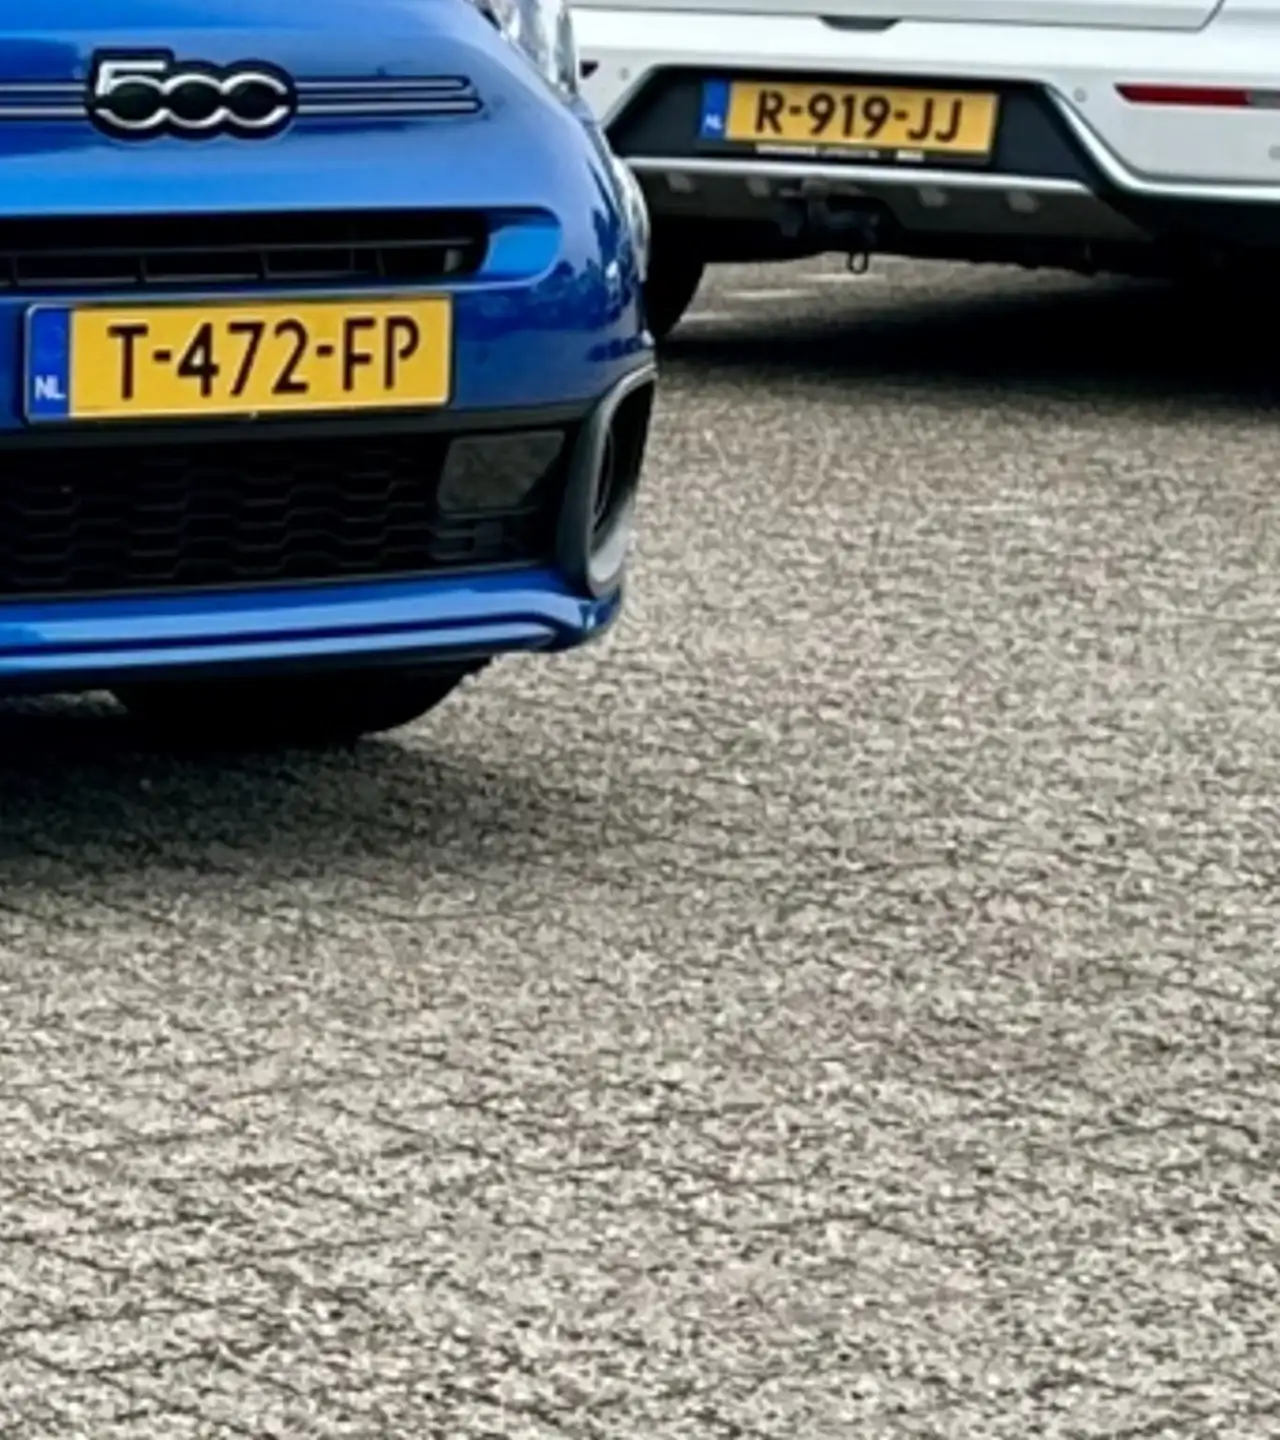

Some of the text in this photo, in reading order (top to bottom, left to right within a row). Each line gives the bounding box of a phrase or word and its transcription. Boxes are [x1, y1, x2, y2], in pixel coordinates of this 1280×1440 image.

[94, 60, 290, 130] 500
[754, 89, 963, 143] R-919-JJ
[34, 315, 420, 401] NL T-472-FP
